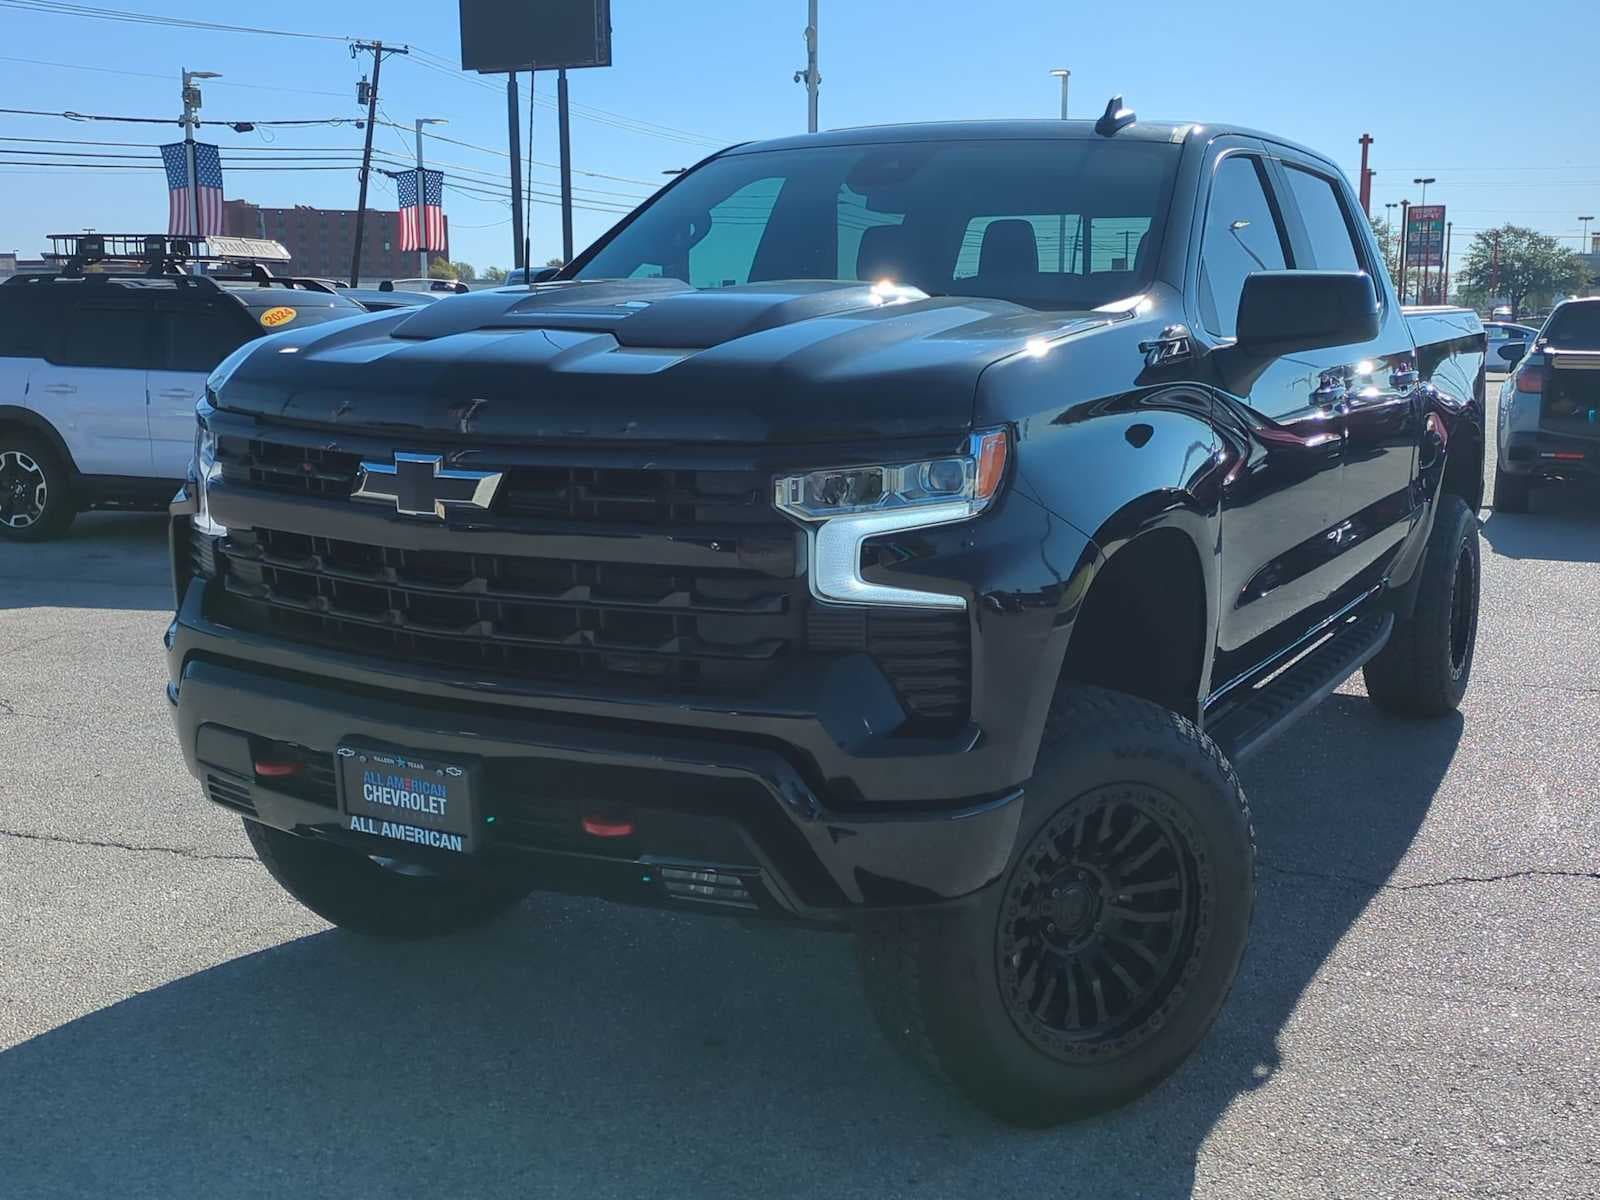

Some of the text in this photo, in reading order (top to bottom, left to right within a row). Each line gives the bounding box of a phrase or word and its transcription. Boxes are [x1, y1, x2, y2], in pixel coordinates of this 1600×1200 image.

[265, 308, 293, 324] 2024
[363, 770, 447, 798] ALL AMERICAN
[363, 784, 447, 815] CHEVROLET
[350, 815, 463, 852] ALL AMERICAN
